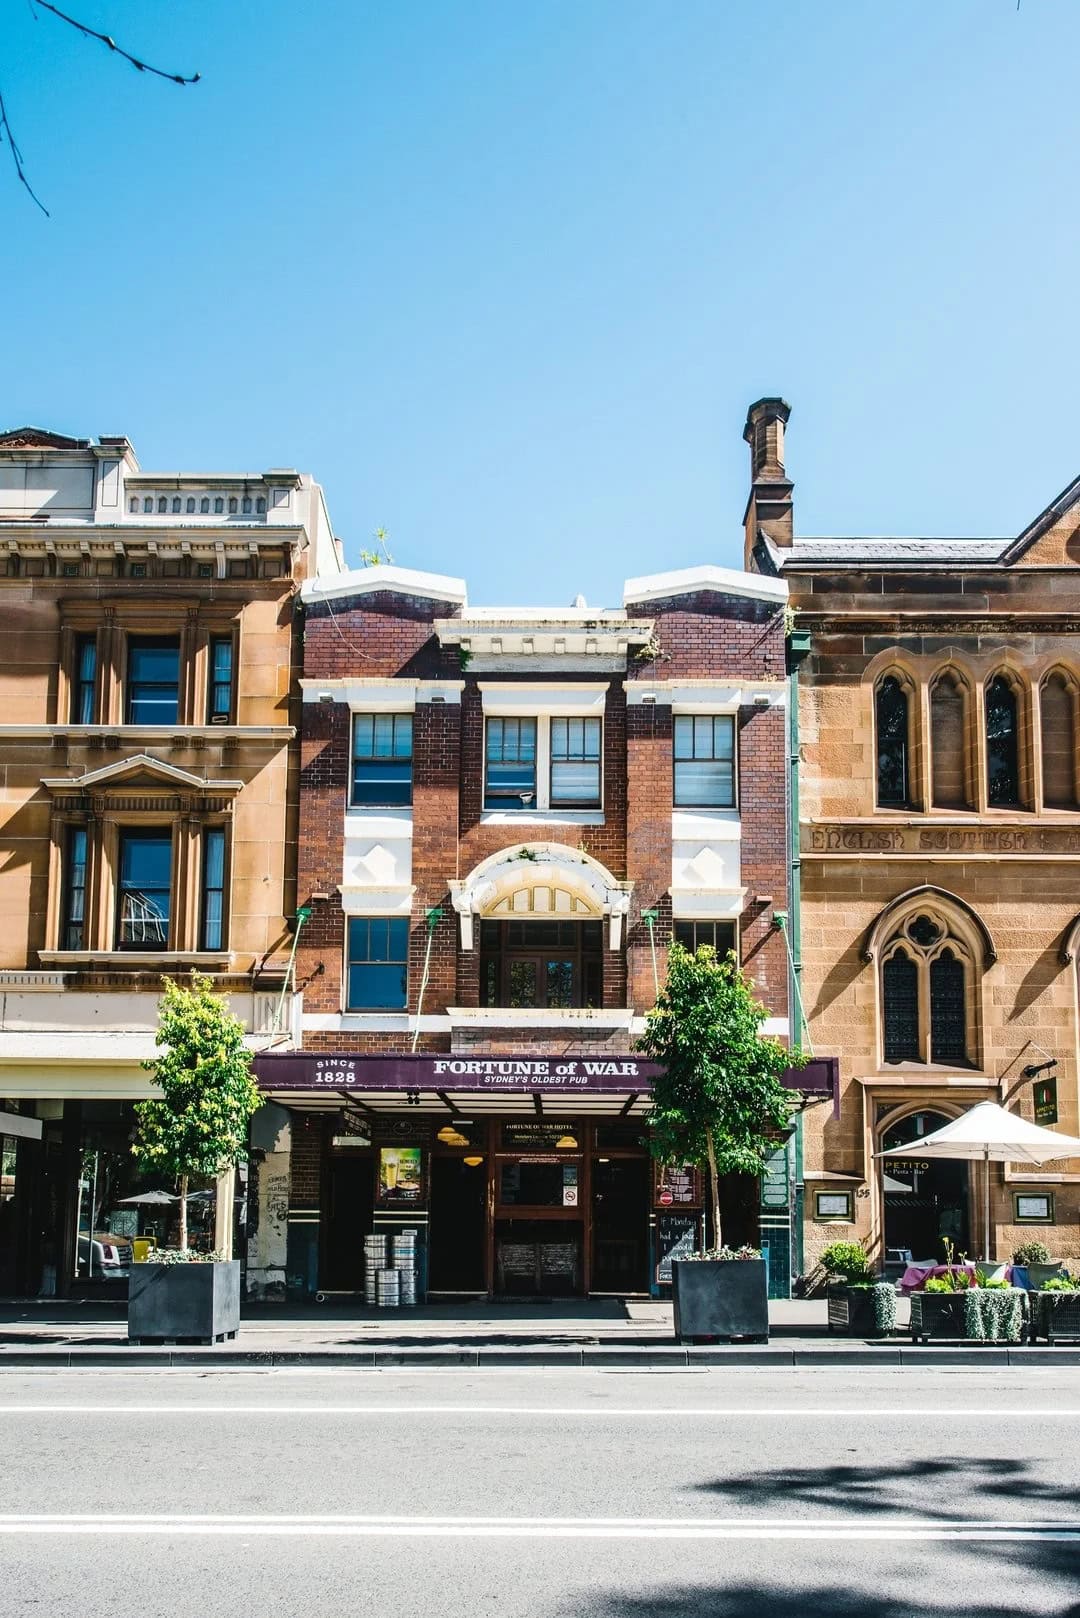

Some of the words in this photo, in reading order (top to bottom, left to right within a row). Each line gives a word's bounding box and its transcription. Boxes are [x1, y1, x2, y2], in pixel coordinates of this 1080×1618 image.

[316, 1059, 356, 1069] SINCE
[434, 1060, 549, 1075] FORTUNE
[555, 1061, 577, 1075] of
[583, 1062, 639, 1076] WAR
[315, 1072, 356, 1083] 1828
[484, 1075, 528, 1084] SYDNEY'S
[531, 1076, 567, 1084] OLDEST
[569, 1077, 588, 1085] PUB
